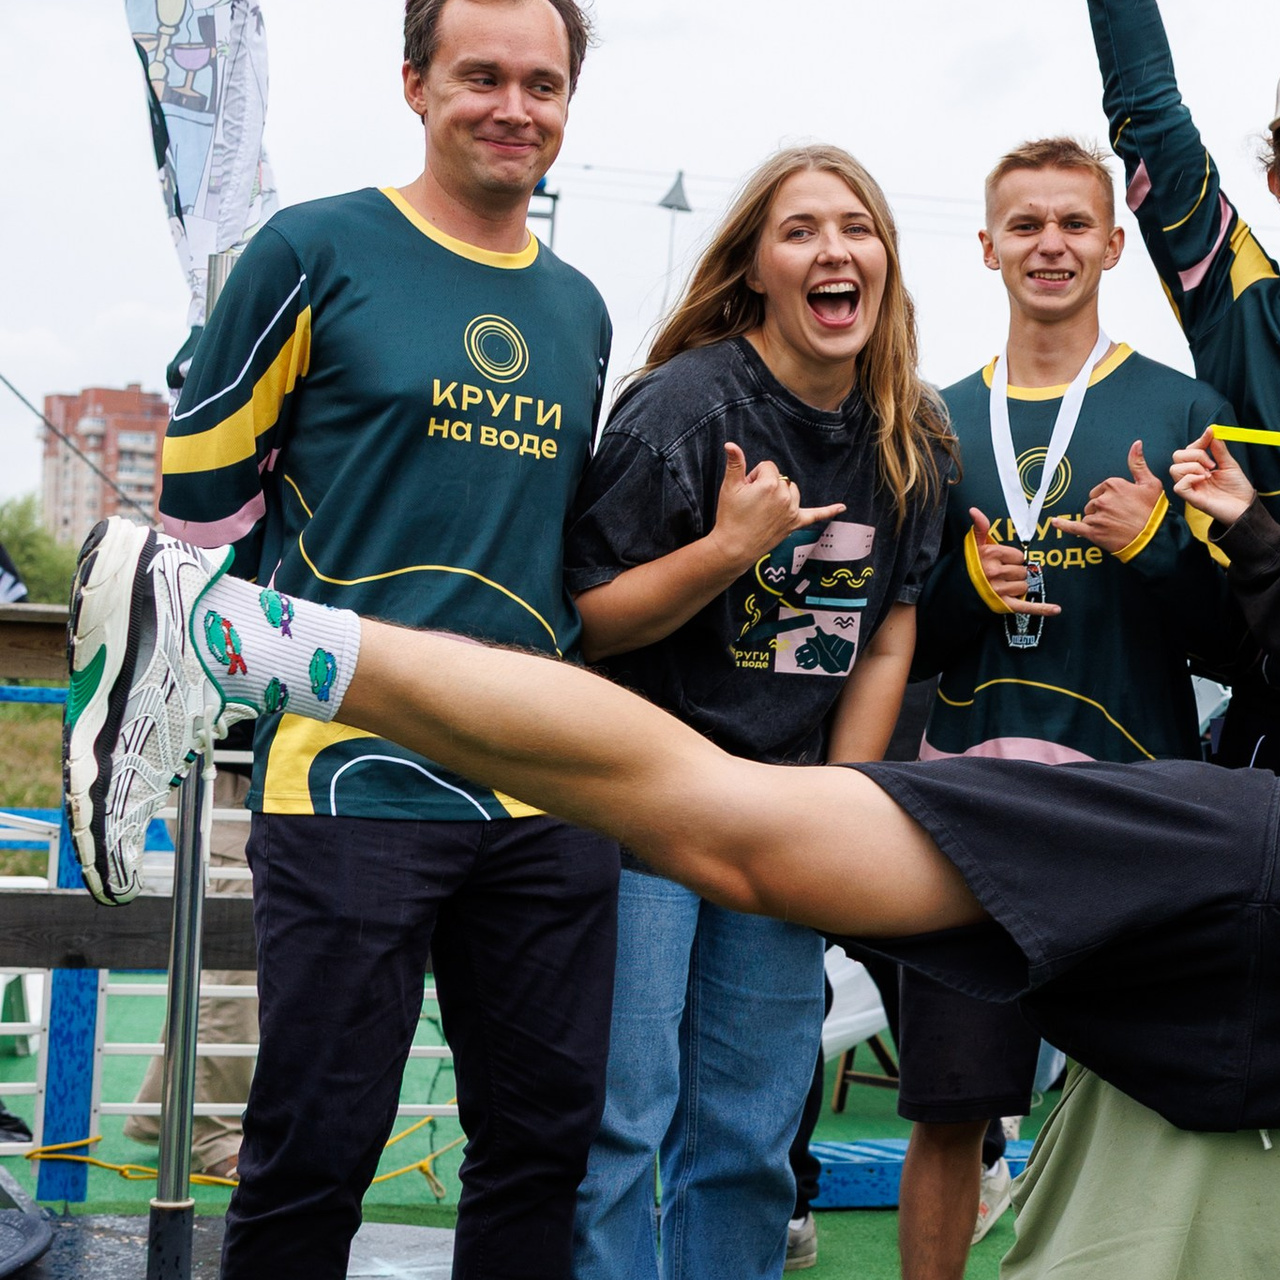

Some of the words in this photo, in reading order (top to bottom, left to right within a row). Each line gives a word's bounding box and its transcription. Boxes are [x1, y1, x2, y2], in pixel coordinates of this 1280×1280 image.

[432, 378, 562, 430] КРУГИ
[427, 417, 473, 442] на
[479, 425, 558, 459] воде
[733, 650, 769, 661] РУГИ
